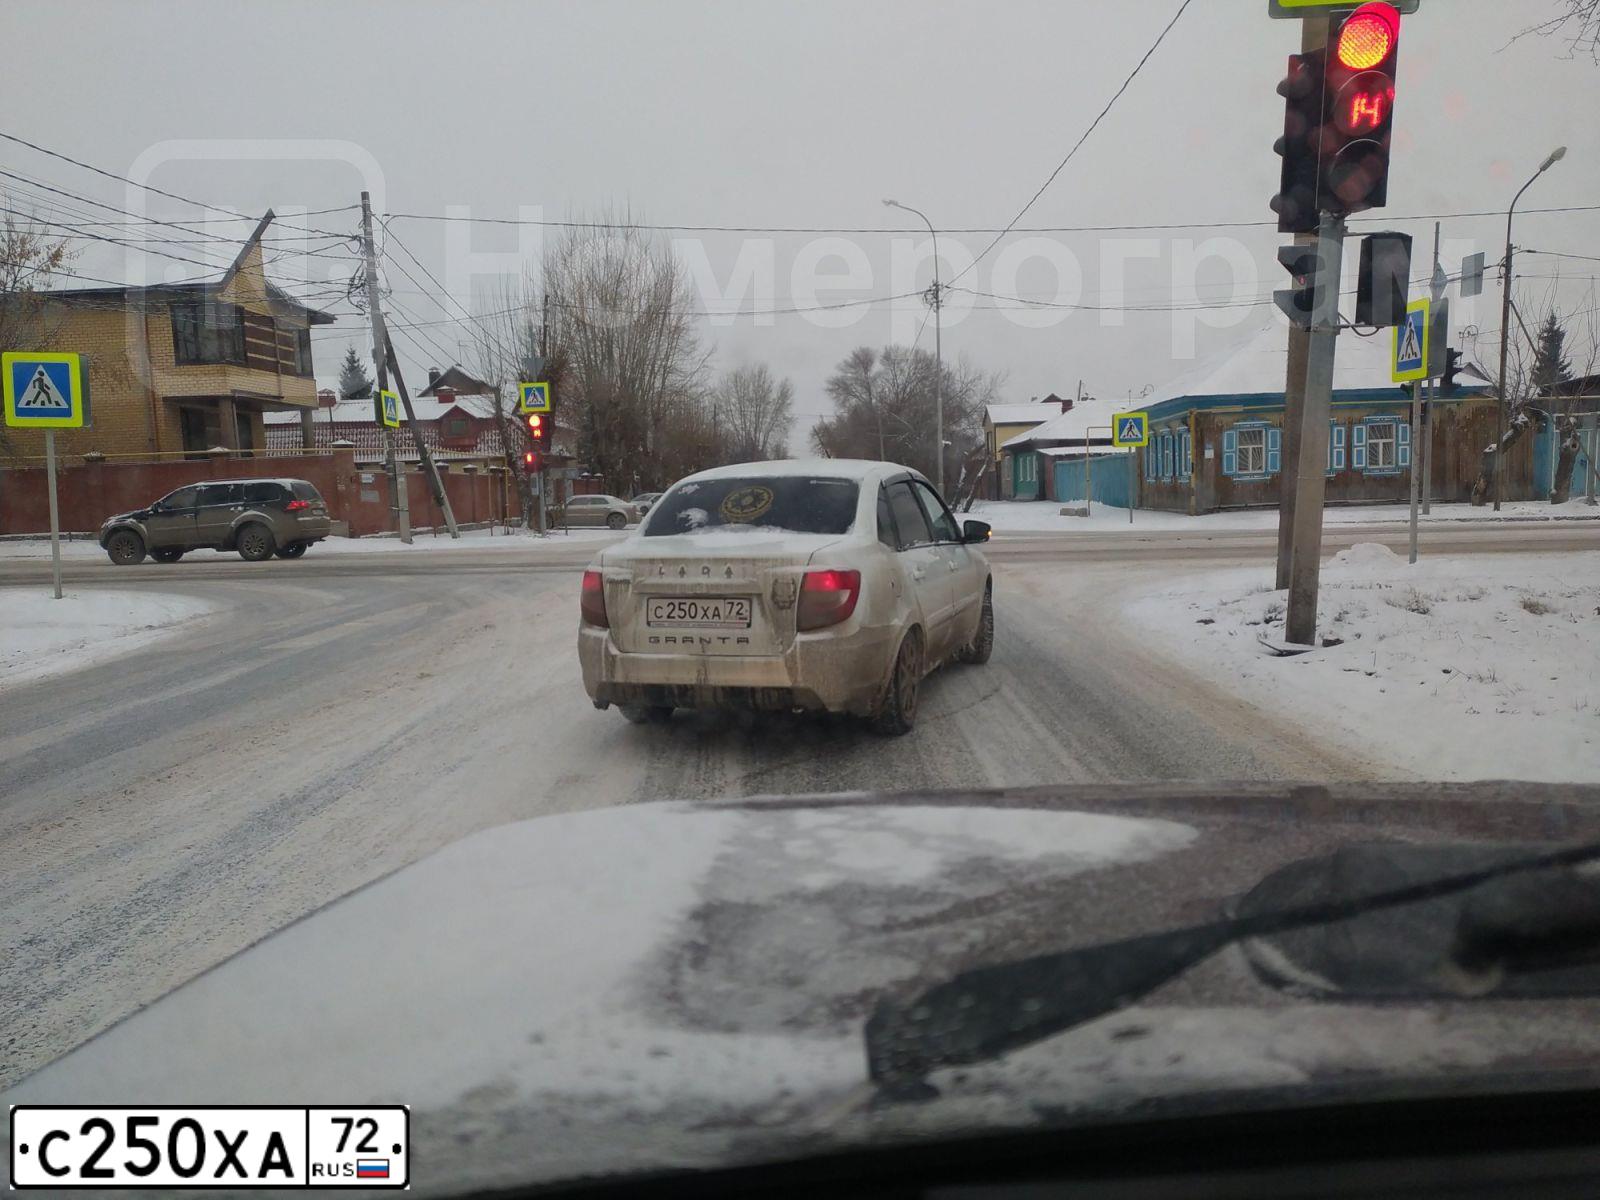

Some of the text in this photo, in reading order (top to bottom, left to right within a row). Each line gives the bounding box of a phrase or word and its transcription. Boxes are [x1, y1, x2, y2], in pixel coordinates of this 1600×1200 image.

[1351, 93, 1382, 128] 14
[726, 601, 745, 616] 72
[648, 636, 750, 645] GRANTA
